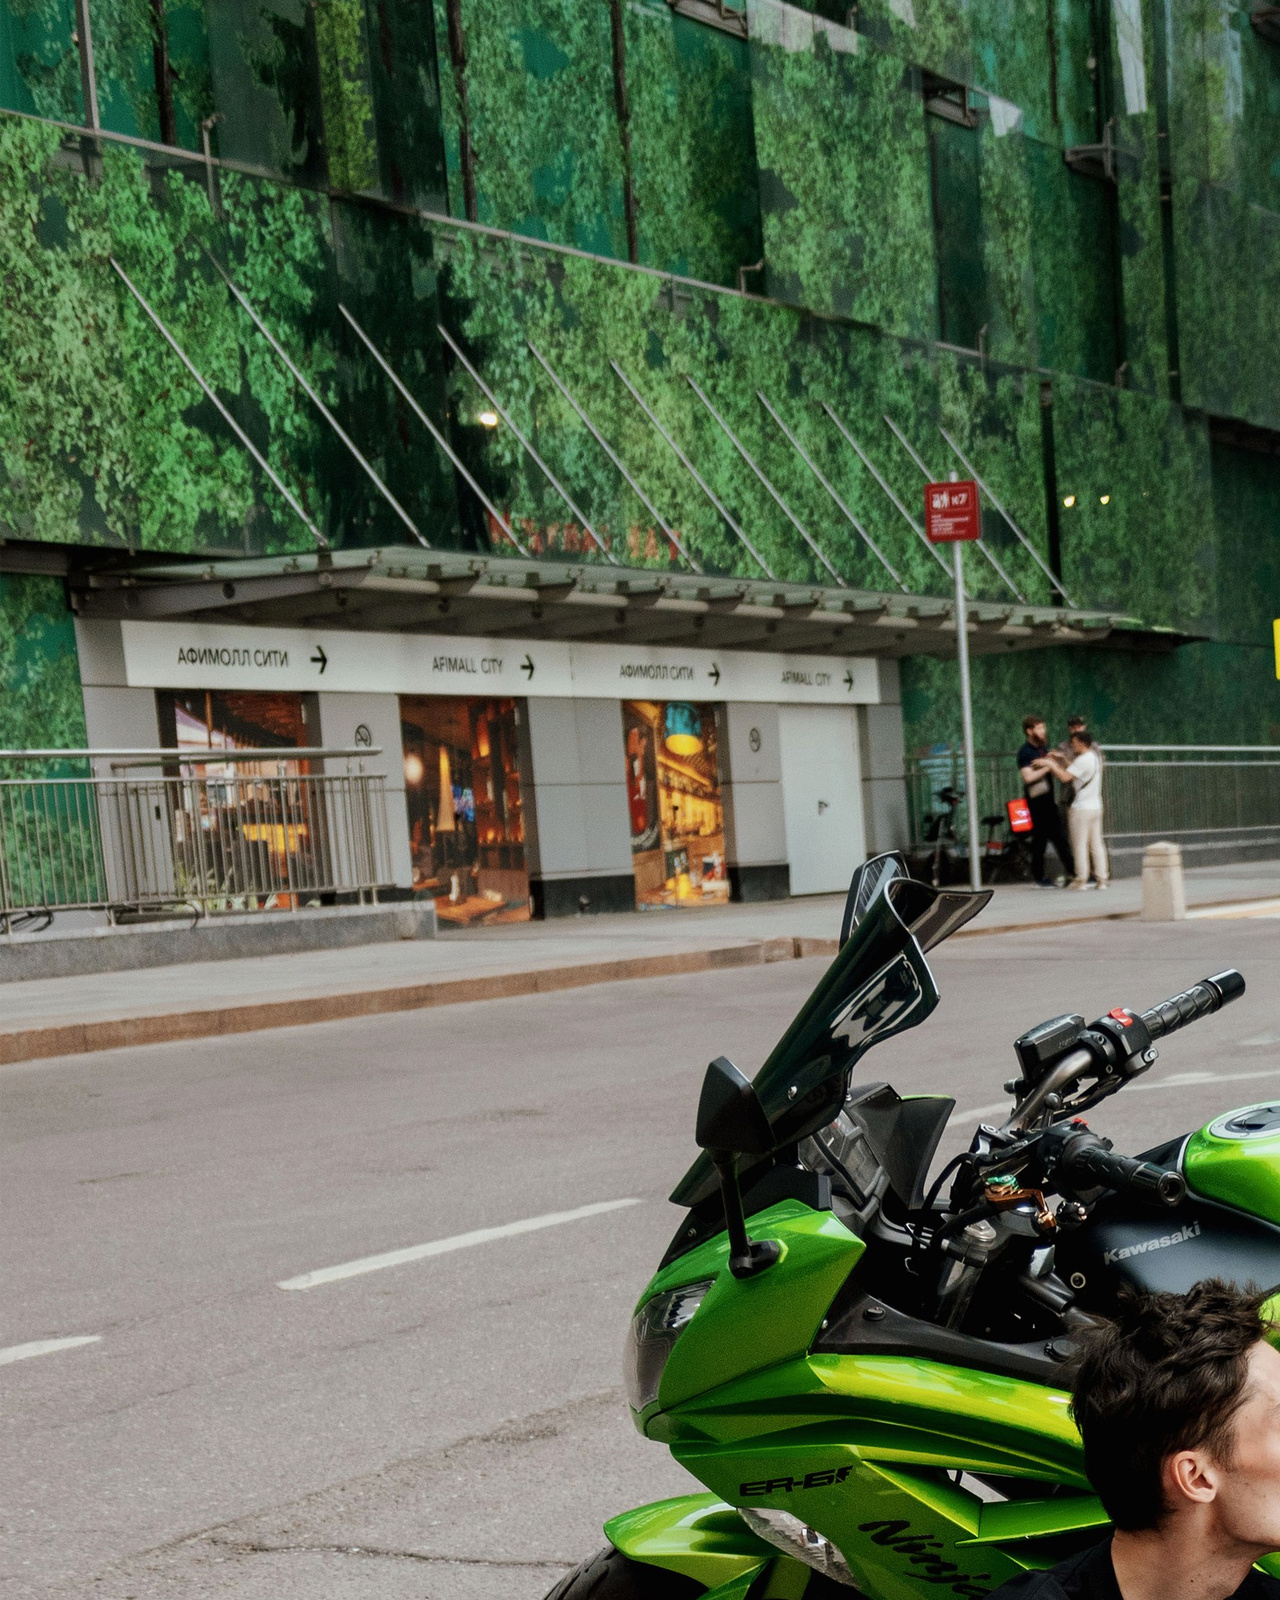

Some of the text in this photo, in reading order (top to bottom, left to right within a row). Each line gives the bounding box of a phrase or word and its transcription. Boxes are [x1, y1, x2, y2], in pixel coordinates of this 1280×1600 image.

[177, 647, 289, 667] АФИМОЛЛ СИТИ
[432, 656, 503, 674] AFIMALL CITY
[620, 664, 668, 680] АФИМОЛЛ
[1103, 1220, 1201, 1266] Kawasaki
